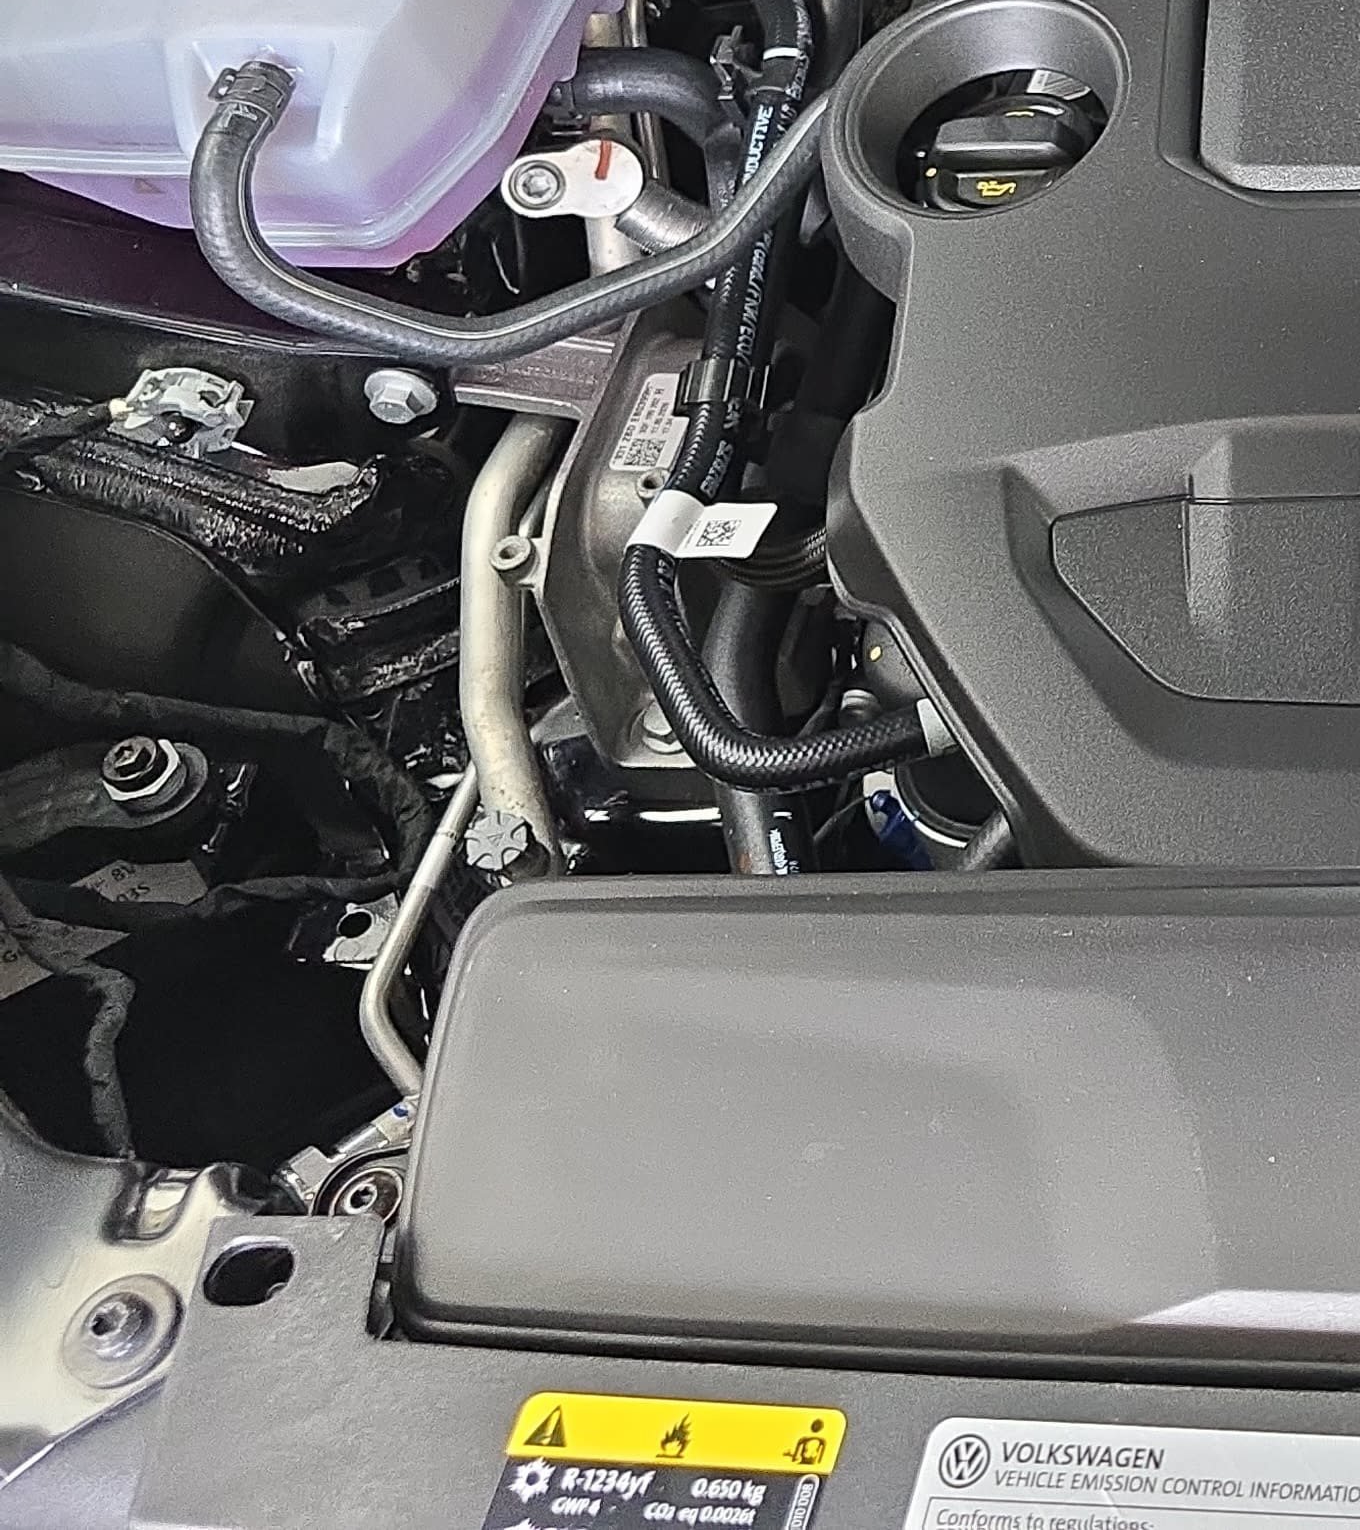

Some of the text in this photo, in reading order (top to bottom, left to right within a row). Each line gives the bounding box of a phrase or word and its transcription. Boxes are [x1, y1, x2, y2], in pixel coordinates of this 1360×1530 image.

[1001, 1440, 1165, 1470] VOLKSWAGEN
[561, 1467, 767, 1507] R-1234yf 0.650 kg
[994, 1469, 1068, 1489] VEHICLE
[1070, 1472, 1158, 1494] EMISSION
[1162, 1477, 1245, 1498] CONTROL
[676, 1507, 699, 1526] eq
[936, 1508, 1020, 1530] Conforms
[1026, 1513, 1044, 1530] to
